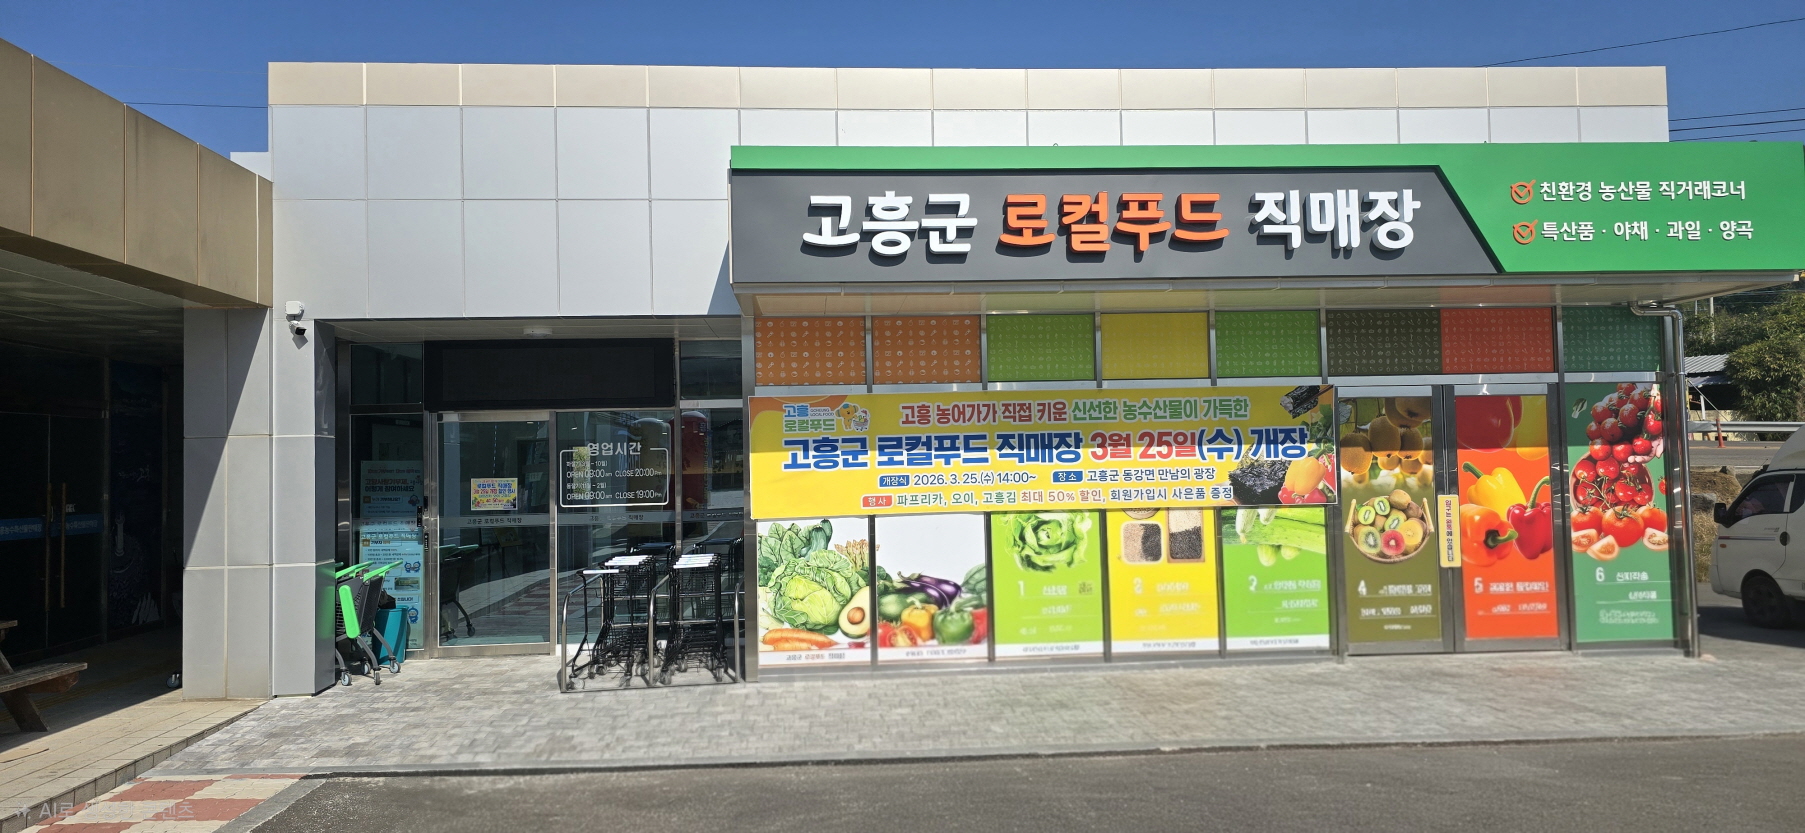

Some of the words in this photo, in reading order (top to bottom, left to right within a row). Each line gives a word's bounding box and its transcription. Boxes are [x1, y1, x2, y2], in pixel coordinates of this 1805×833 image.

[1539, 181, 1592, 202] 친환경
[1598, 181, 1653, 202] 농산물
[1659, 180, 1747, 201] 직거래코너
[803, 190, 978, 257] 고흥군
[1000, 190, 1230, 252] 로컬푸드
[1253, 188, 1421, 252] 직매장
[1541, 221, 1595, 242] 특산품
[1613, 220, 1649, 242] 야채
[1666, 219, 1702, 241] 과일
[1719, 219, 1755, 241] 양곡
[784, 404, 809, 418] 고흥
[901, 403, 932, 424] 고흥
[936, 402, 997, 424] 농어가가
[1001, 402, 1033, 423] 직접
[1036, 401, 1067, 422] 키운
[1071, 400, 1118, 422] 신선한
[1123, 399, 1198, 421] 농수산물이
[1203, 398, 1249, 419] 가득한
[784, 418, 836, 433] 로컬푸드
[587, 442, 642, 456] 영업시간
[784, 436, 869, 470] 고흥군
[877, 434, 990, 467] 로컬푸드
[996, 432, 1082, 464] 직매장
[1090, 431, 1131, 461] 3월
[1138, 428, 1242, 460] 25일(수)
[1249, 427, 1308, 460] 개장
[882, 475, 907, 486] 개장식
[996, 472, 1036, 484] 14:00~
[1087, 469, 1120, 482] 고흥군
[1123, 469, 1155, 481] 동강면
[1158, 468, 1190, 481] 만남의
[1194, 467, 1216, 480] 광장
[615, 491, 635, 499] CLOSE
[897, 495, 947, 507] 파프리카,
[952, 492, 979, 506] 오이,
[983, 492, 1016, 504] 고흥김
[1021, 490, 1044, 503] 최대
[1048, 490, 1075, 503] 50%
[1079, 489, 1107, 503] 할인,
[1110, 489, 1167, 502] 회원가입시
[1171, 487, 1205, 500] 사은품
[1209, 486, 1233, 500] 증정
[1595, 567, 1605, 582] 6
